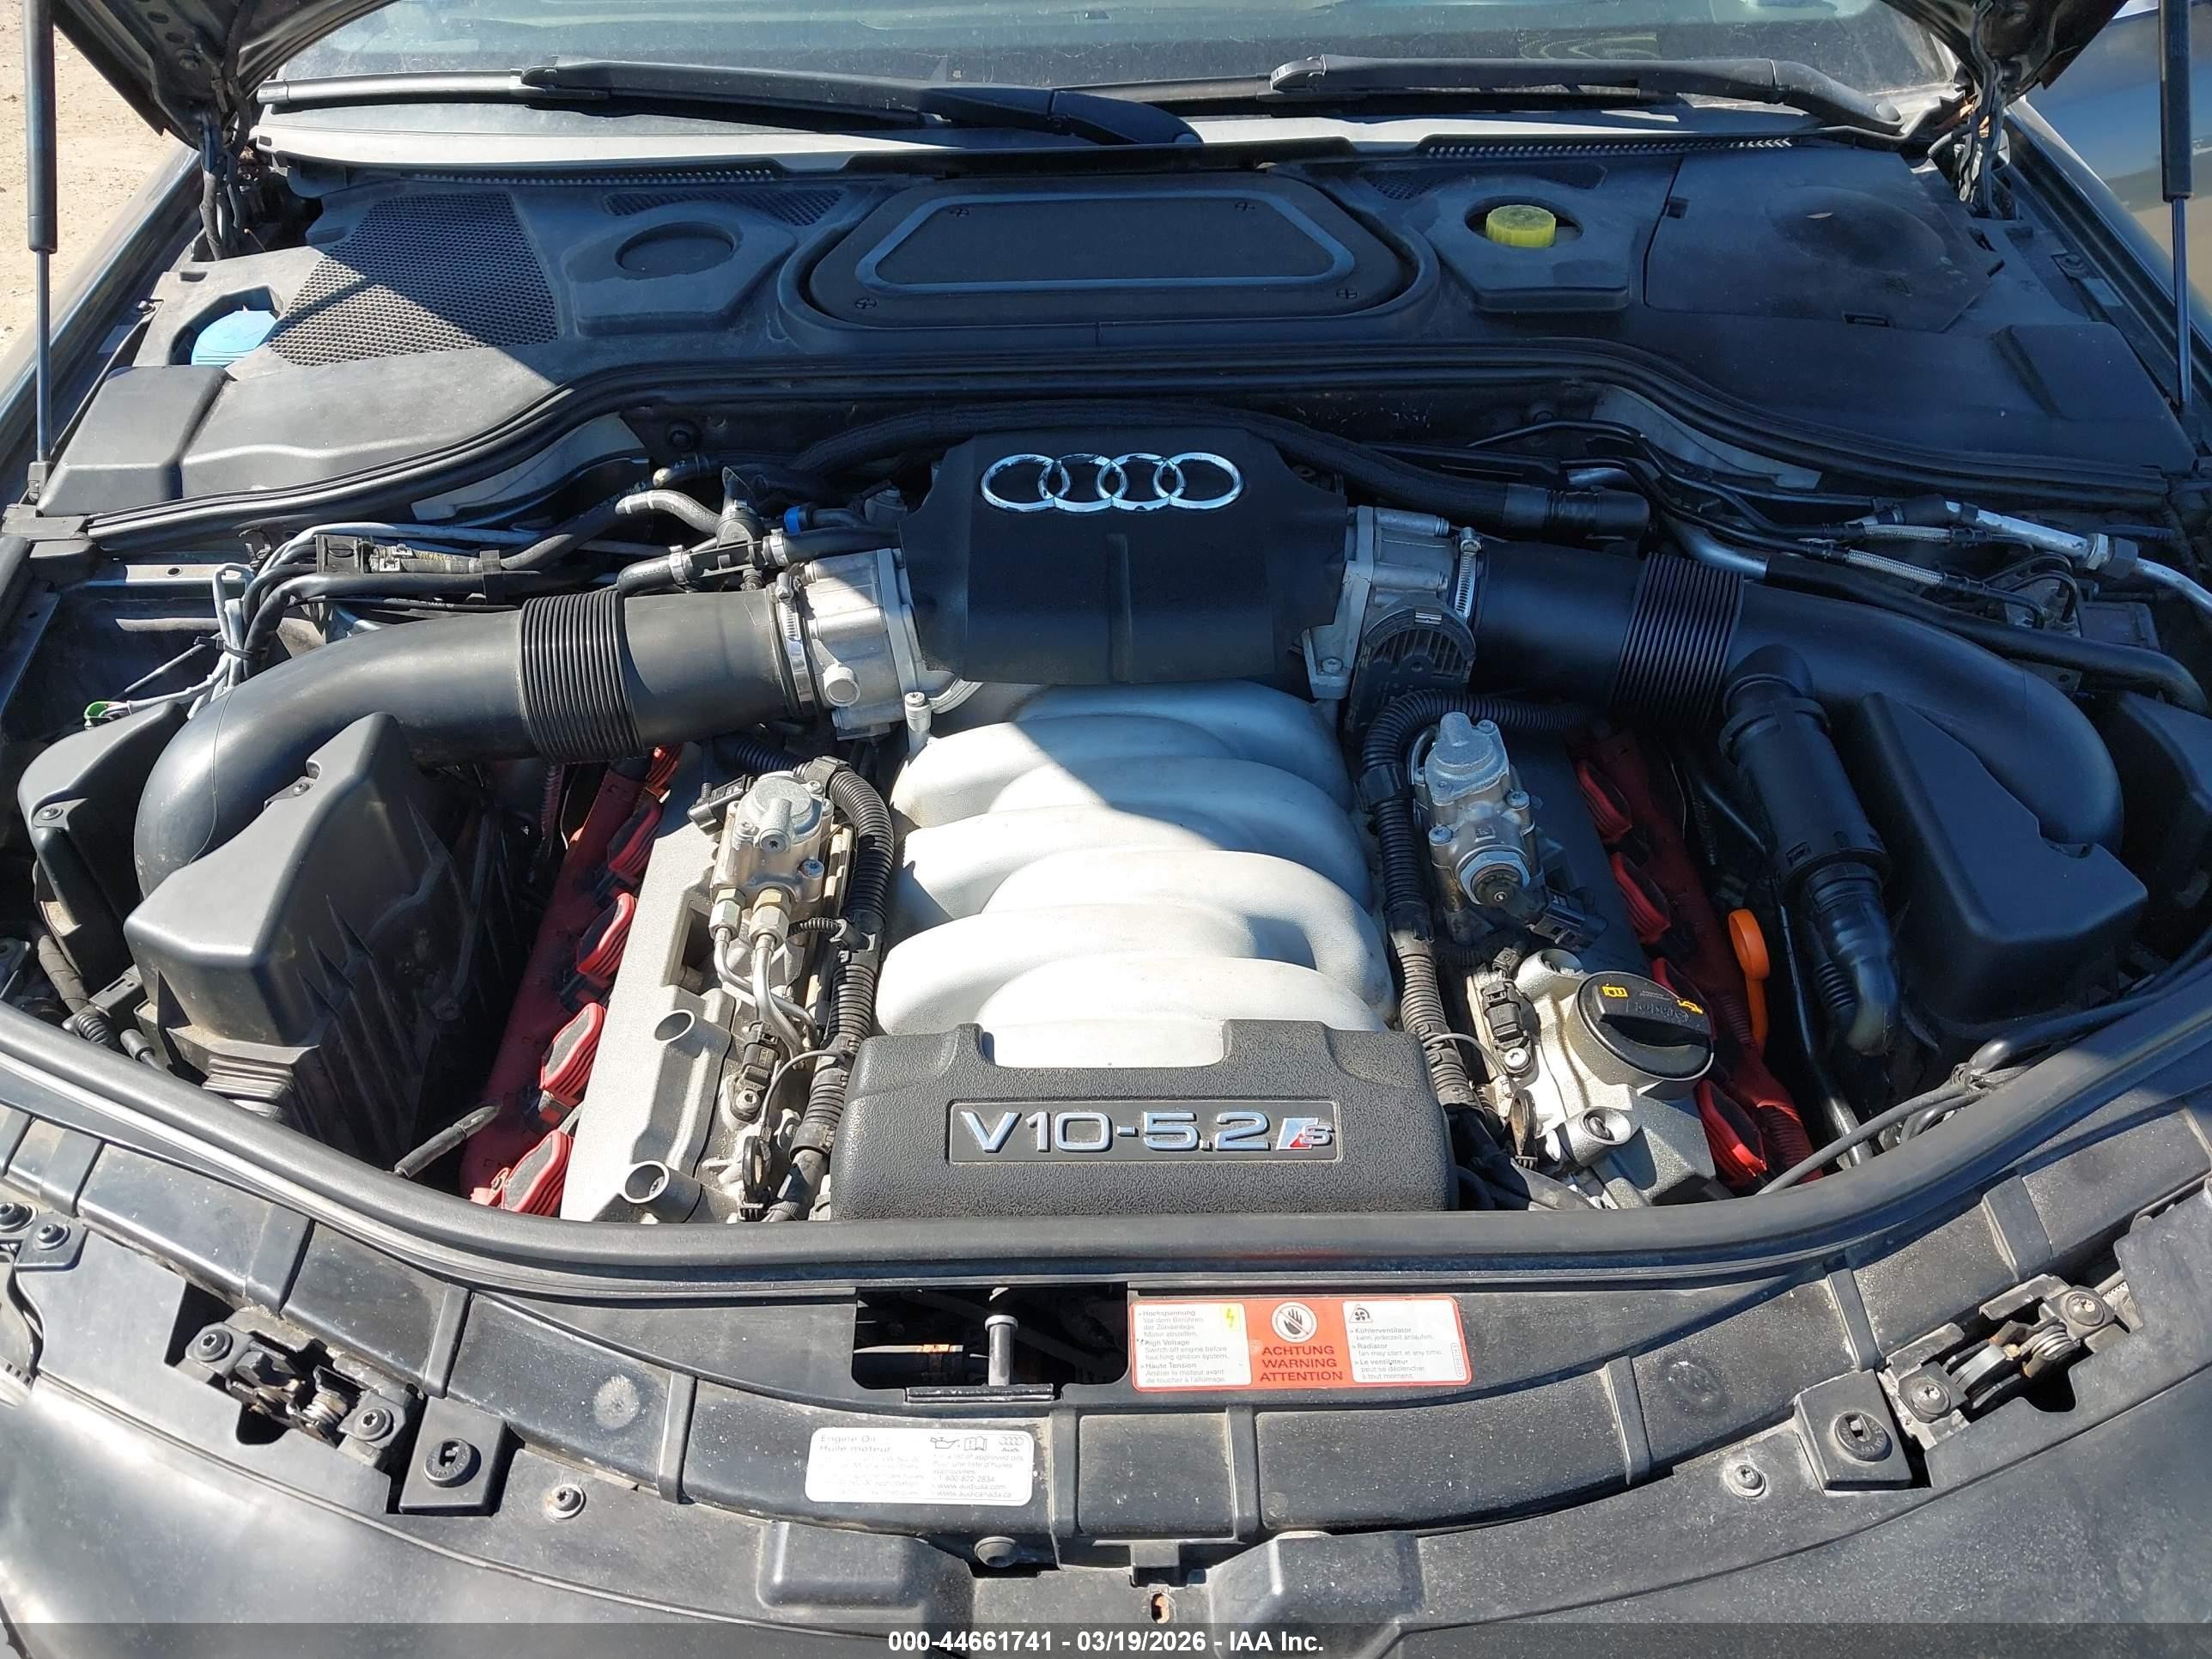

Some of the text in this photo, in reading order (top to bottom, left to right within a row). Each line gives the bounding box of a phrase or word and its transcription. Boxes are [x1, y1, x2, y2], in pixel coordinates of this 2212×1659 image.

[961, 1111, 1270, 1152] V10-5.2
[1142, 1310, 1196, 1318] Hochspannung
[1261, 1346, 1334, 1356] ACHTUNG
[1261, 1358, 1337, 1369] WARNING
[1260, 1371, 1343, 1382] ATTENTION
[821, 1435, 857, 1444] Engine
